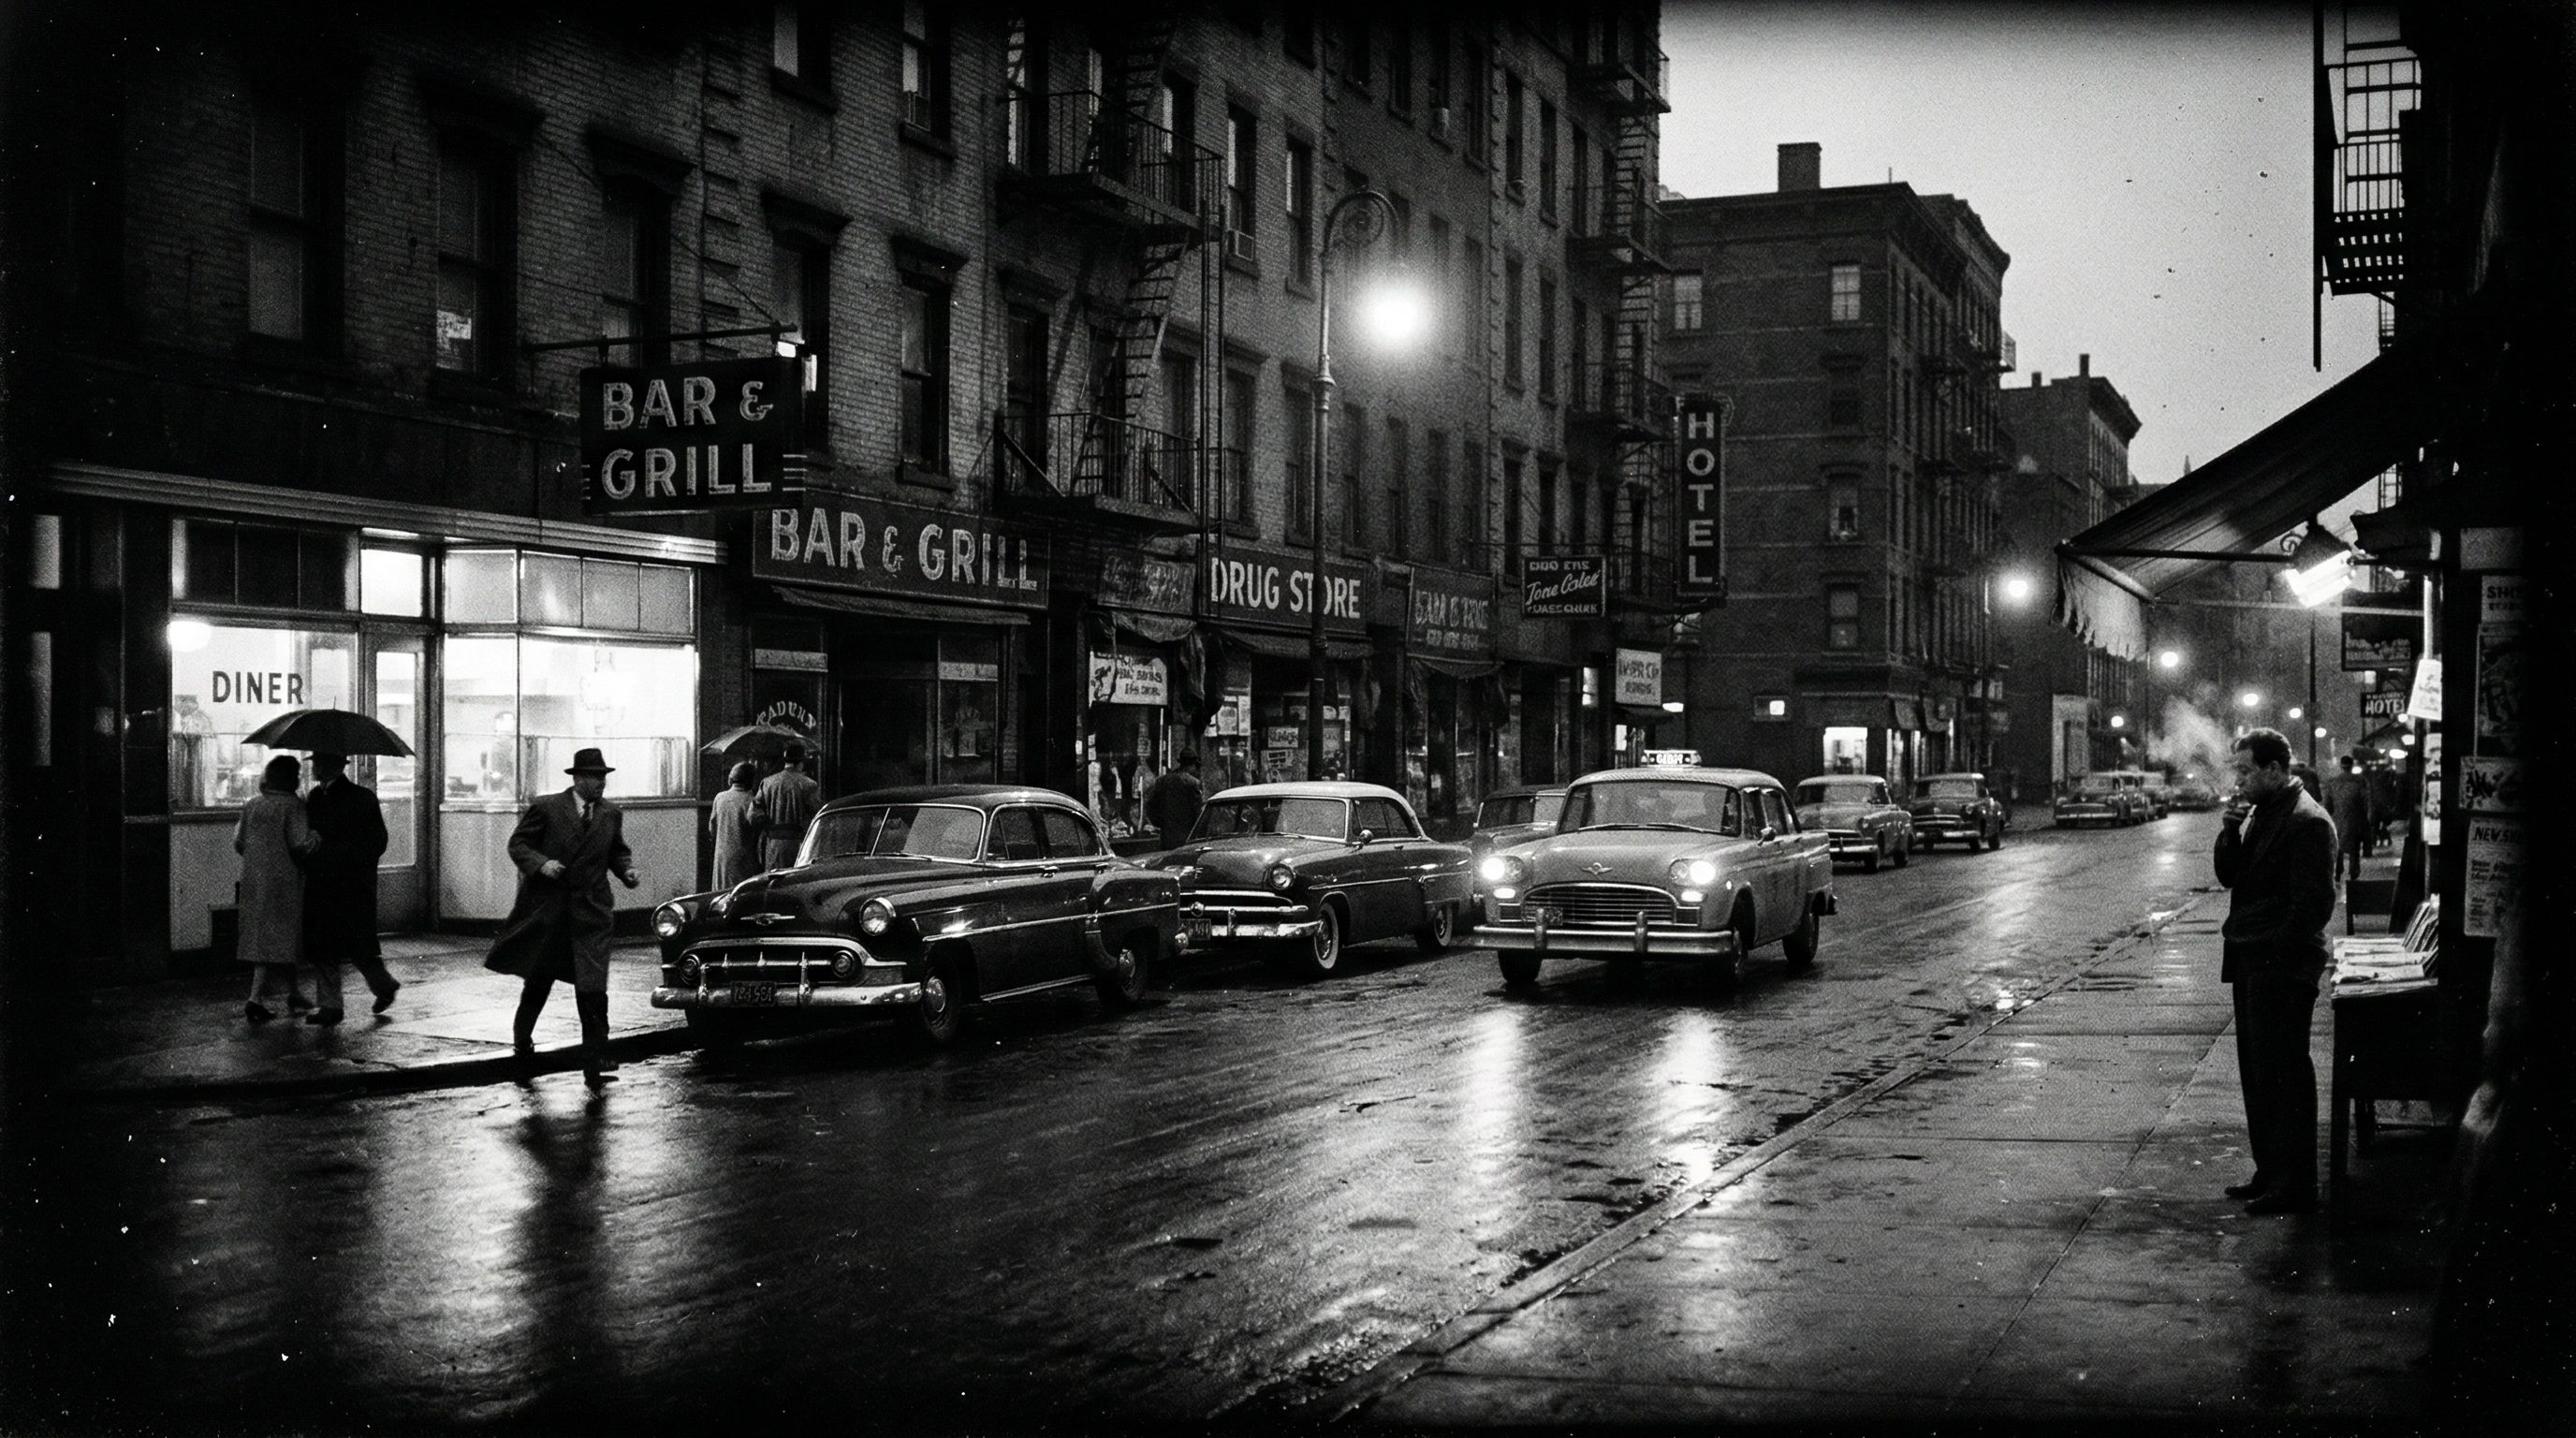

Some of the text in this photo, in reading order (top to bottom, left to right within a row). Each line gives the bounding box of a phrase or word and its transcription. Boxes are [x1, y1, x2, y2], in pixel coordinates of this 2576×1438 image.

[603, 376, 774, 430] BAR &
[601, 444, 772, 500] GRILL
[1687, 412, 1715, 583] HOTEL
[771, 507, 865, 570] BAR
[883, 526, 904, 573] &
[918, 523, 1037, 591] GRILL
[1211, 557, 1280, 609] DRUG
[212, 670, 303, 704] DINER
